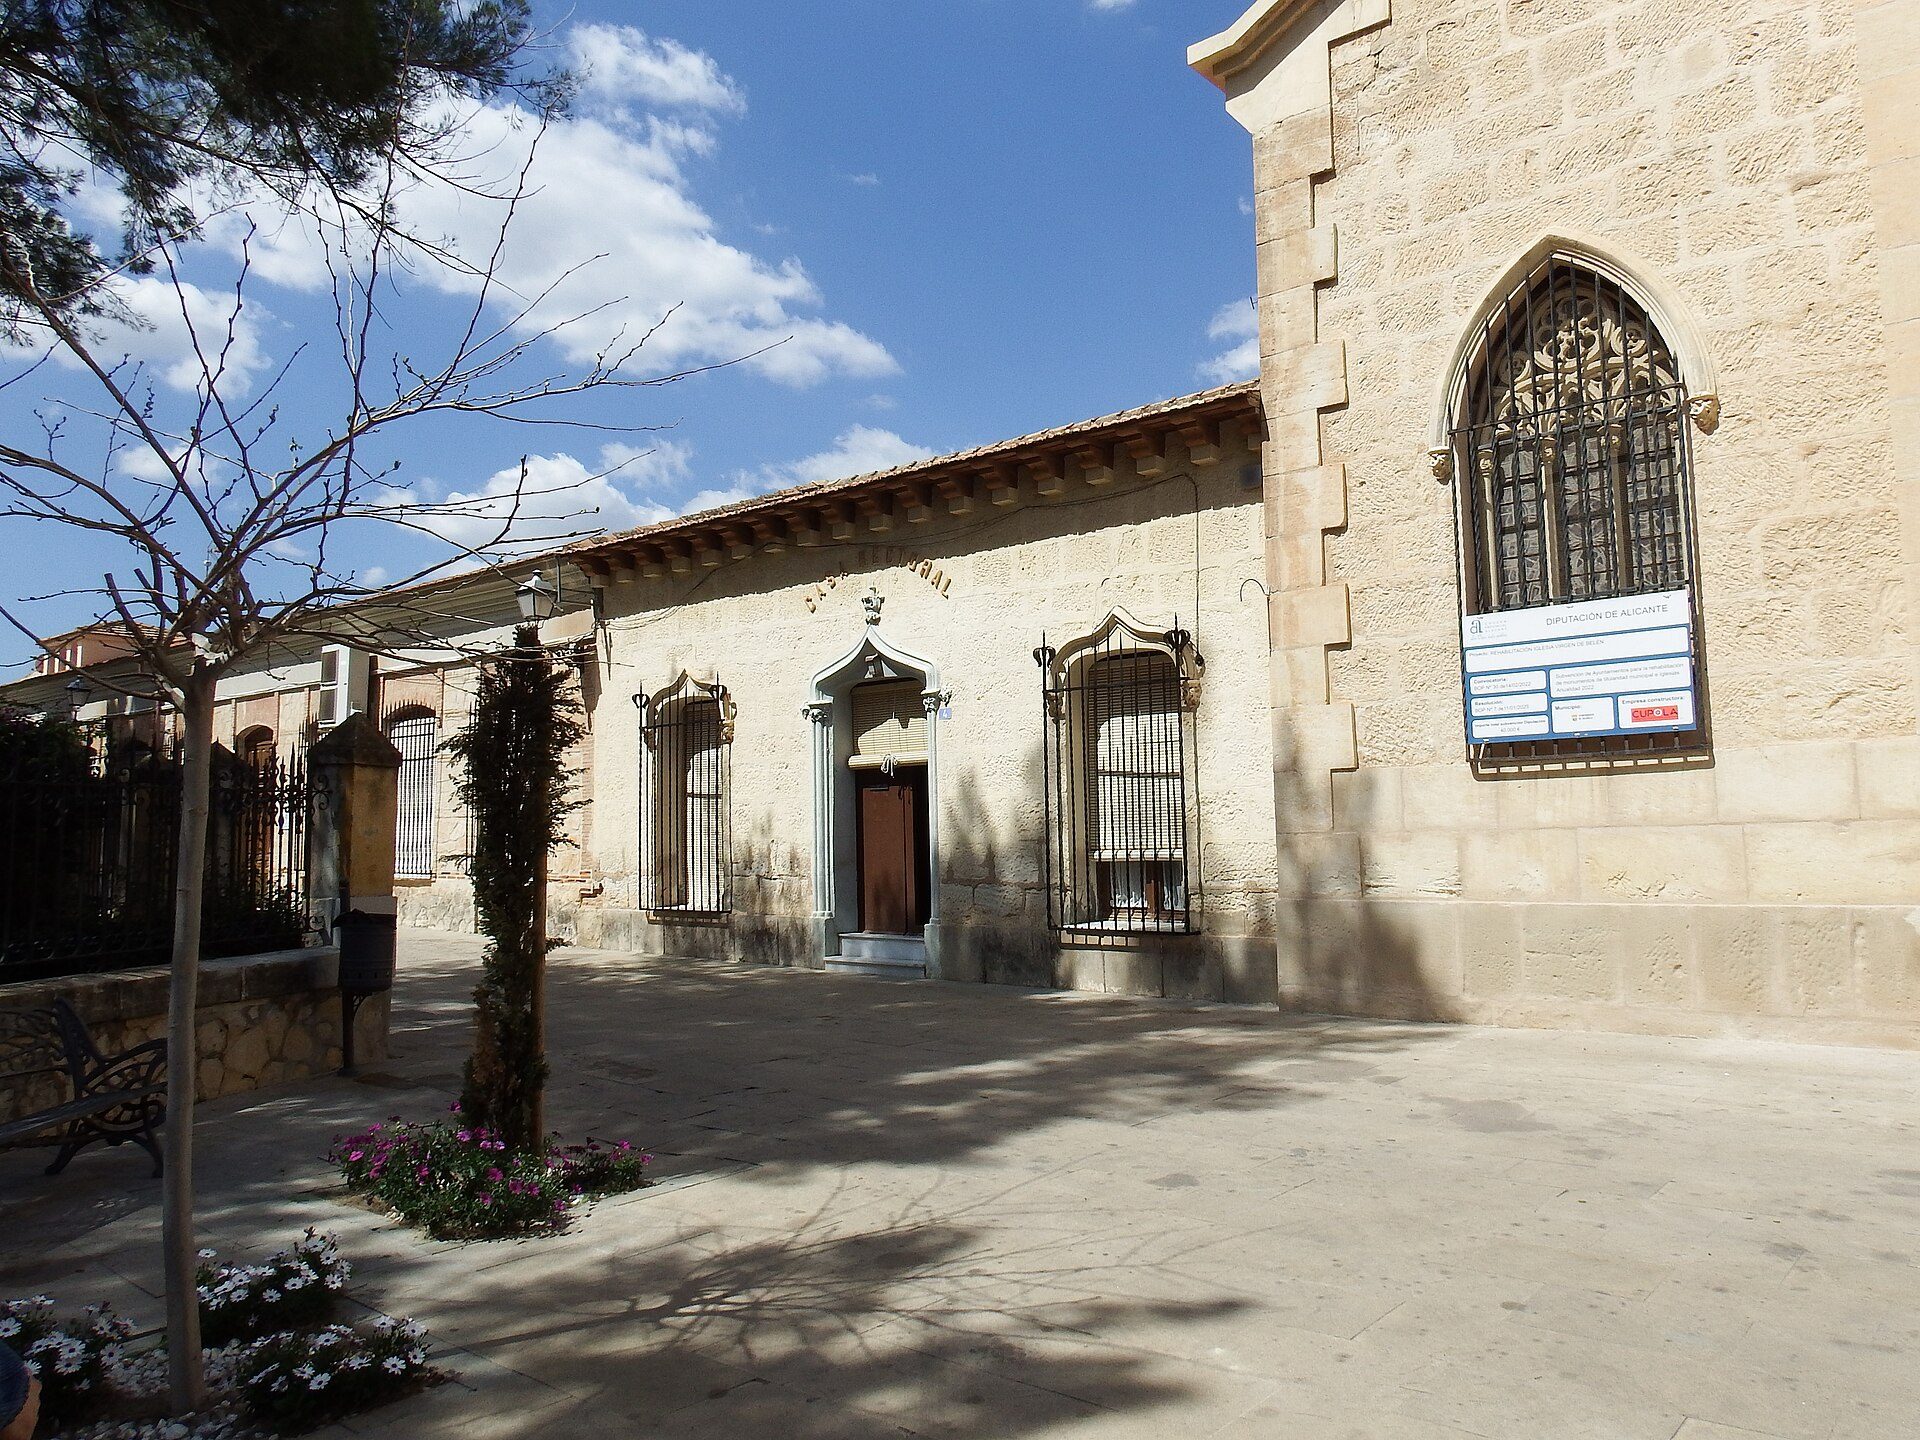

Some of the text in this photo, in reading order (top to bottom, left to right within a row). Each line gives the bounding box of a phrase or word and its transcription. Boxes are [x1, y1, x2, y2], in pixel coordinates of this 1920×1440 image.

[1546, 604, 1669, 626] DIPUTACIÓN DE ALICANTE
[1490, 646, 1533, 655] REHABILITACIÓN
[1632, 707, 1678, 718] CUPOLA
